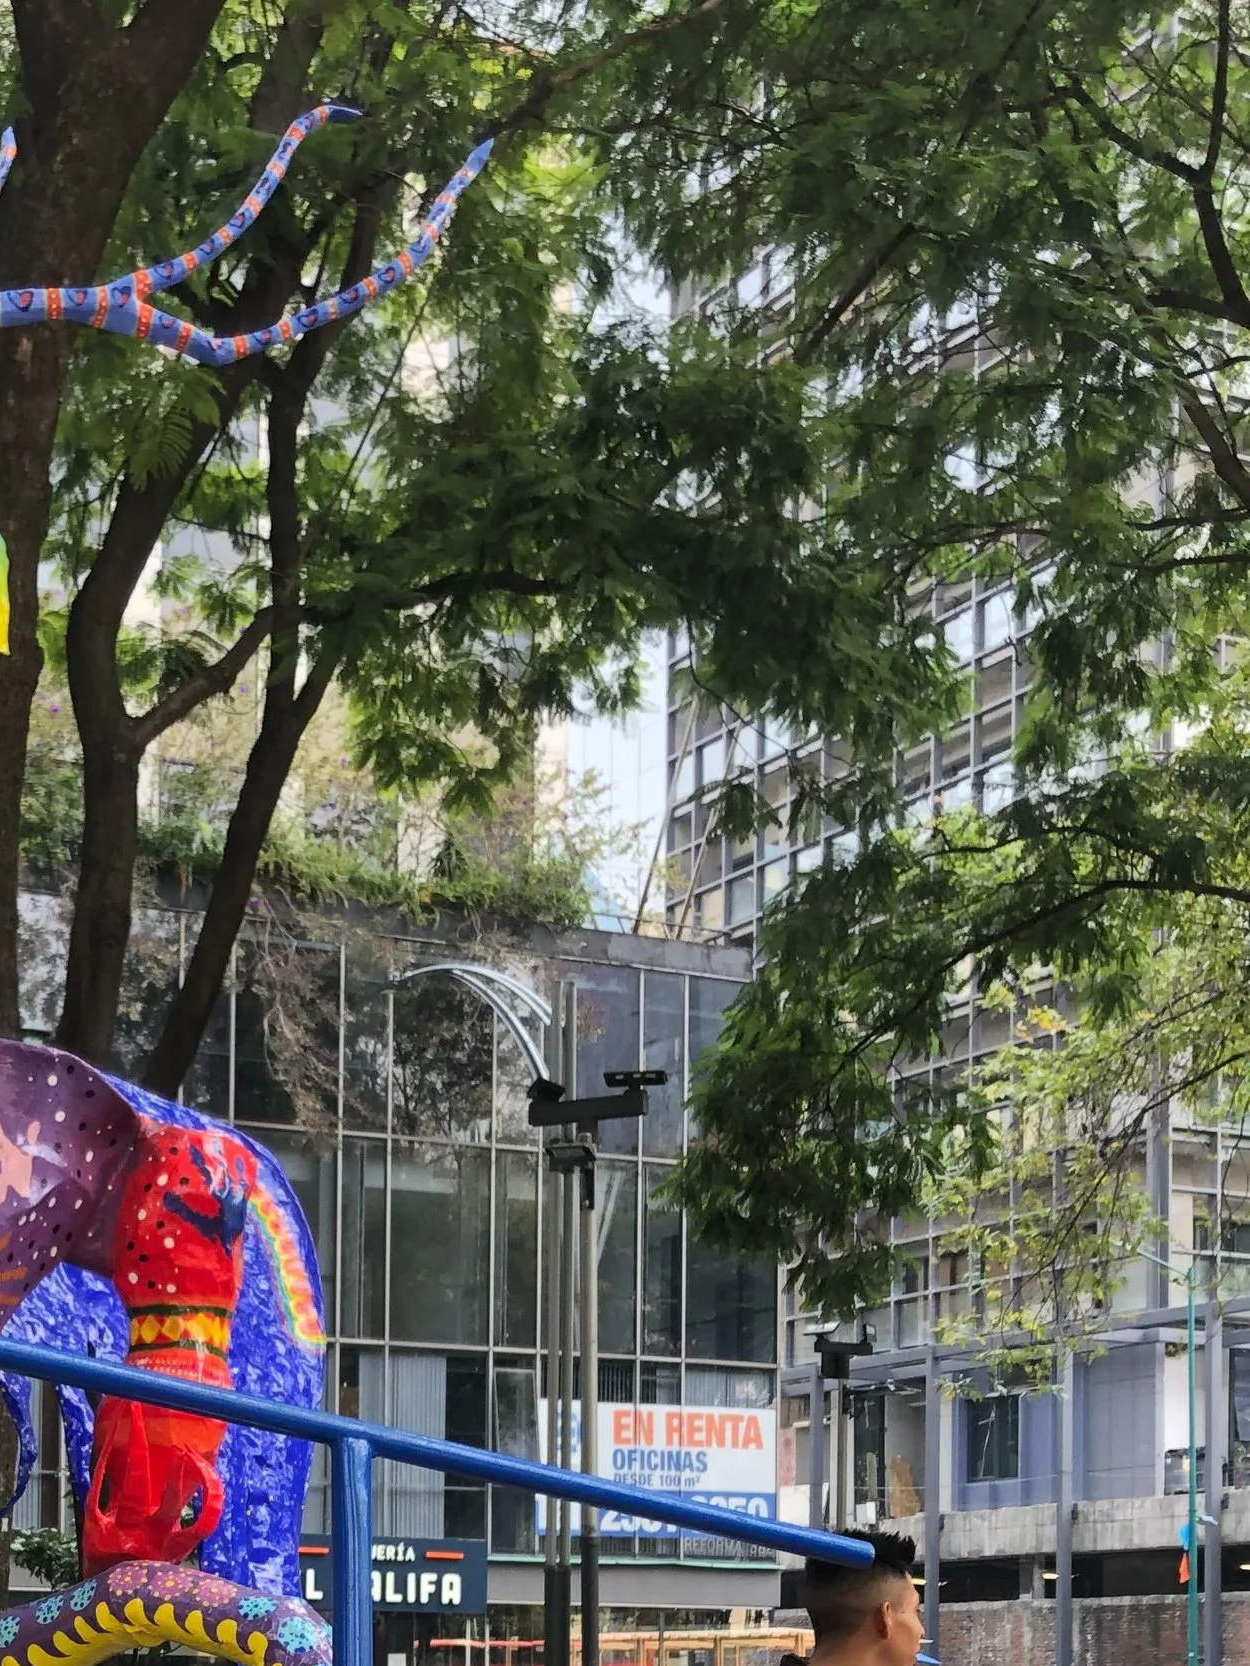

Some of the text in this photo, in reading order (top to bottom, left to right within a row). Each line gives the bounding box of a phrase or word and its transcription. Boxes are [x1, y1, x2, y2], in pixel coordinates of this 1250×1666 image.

[613, 1410, 764, 1450] EN RENTA
[613, 1449, 708, 1473] OFICINAS
[613, 1473, 654, 1487] DESDE
[658, 1474, 681, 1488] 100
[304, 1567, 462, 1606] L ALIFA
